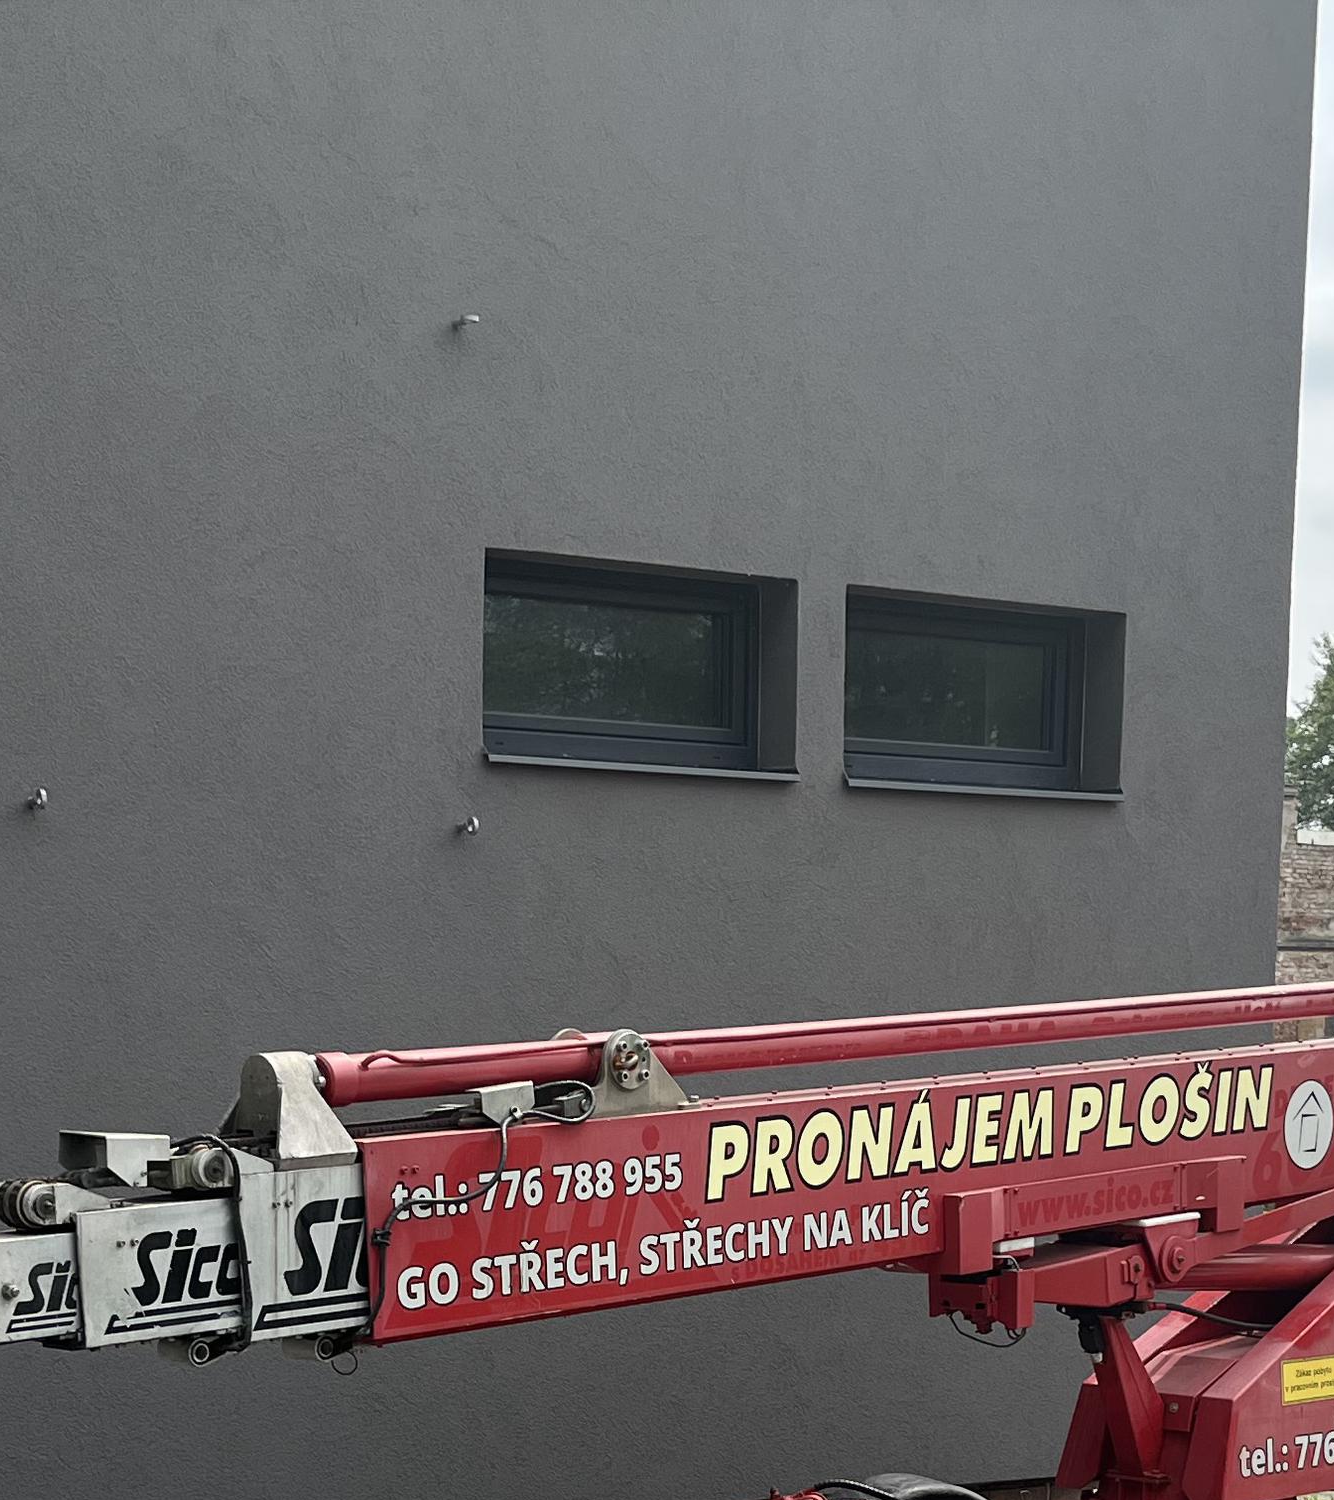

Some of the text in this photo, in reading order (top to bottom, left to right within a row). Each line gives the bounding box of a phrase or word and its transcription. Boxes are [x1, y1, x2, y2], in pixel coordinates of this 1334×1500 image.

[706, 1087, 1055, 1203] PRONÁJEM
[1063, 1061, 1274, 1157] PLOŠIN
[391, 1153, 683, 1221] tel.: 776 788 955
[283, 1196, 367, 1297] Si
[397, 1263, 460, 1310] GO
[471, 1239, 629, 1300] STŘECH,
[639, 1216, 794, 1276] STŘECHY
[804, 1209, 853, 1252] NA
[861, 1188, 930, 1242] KLÍČ
[1239, 1438, 1289, 1478] tel.:
